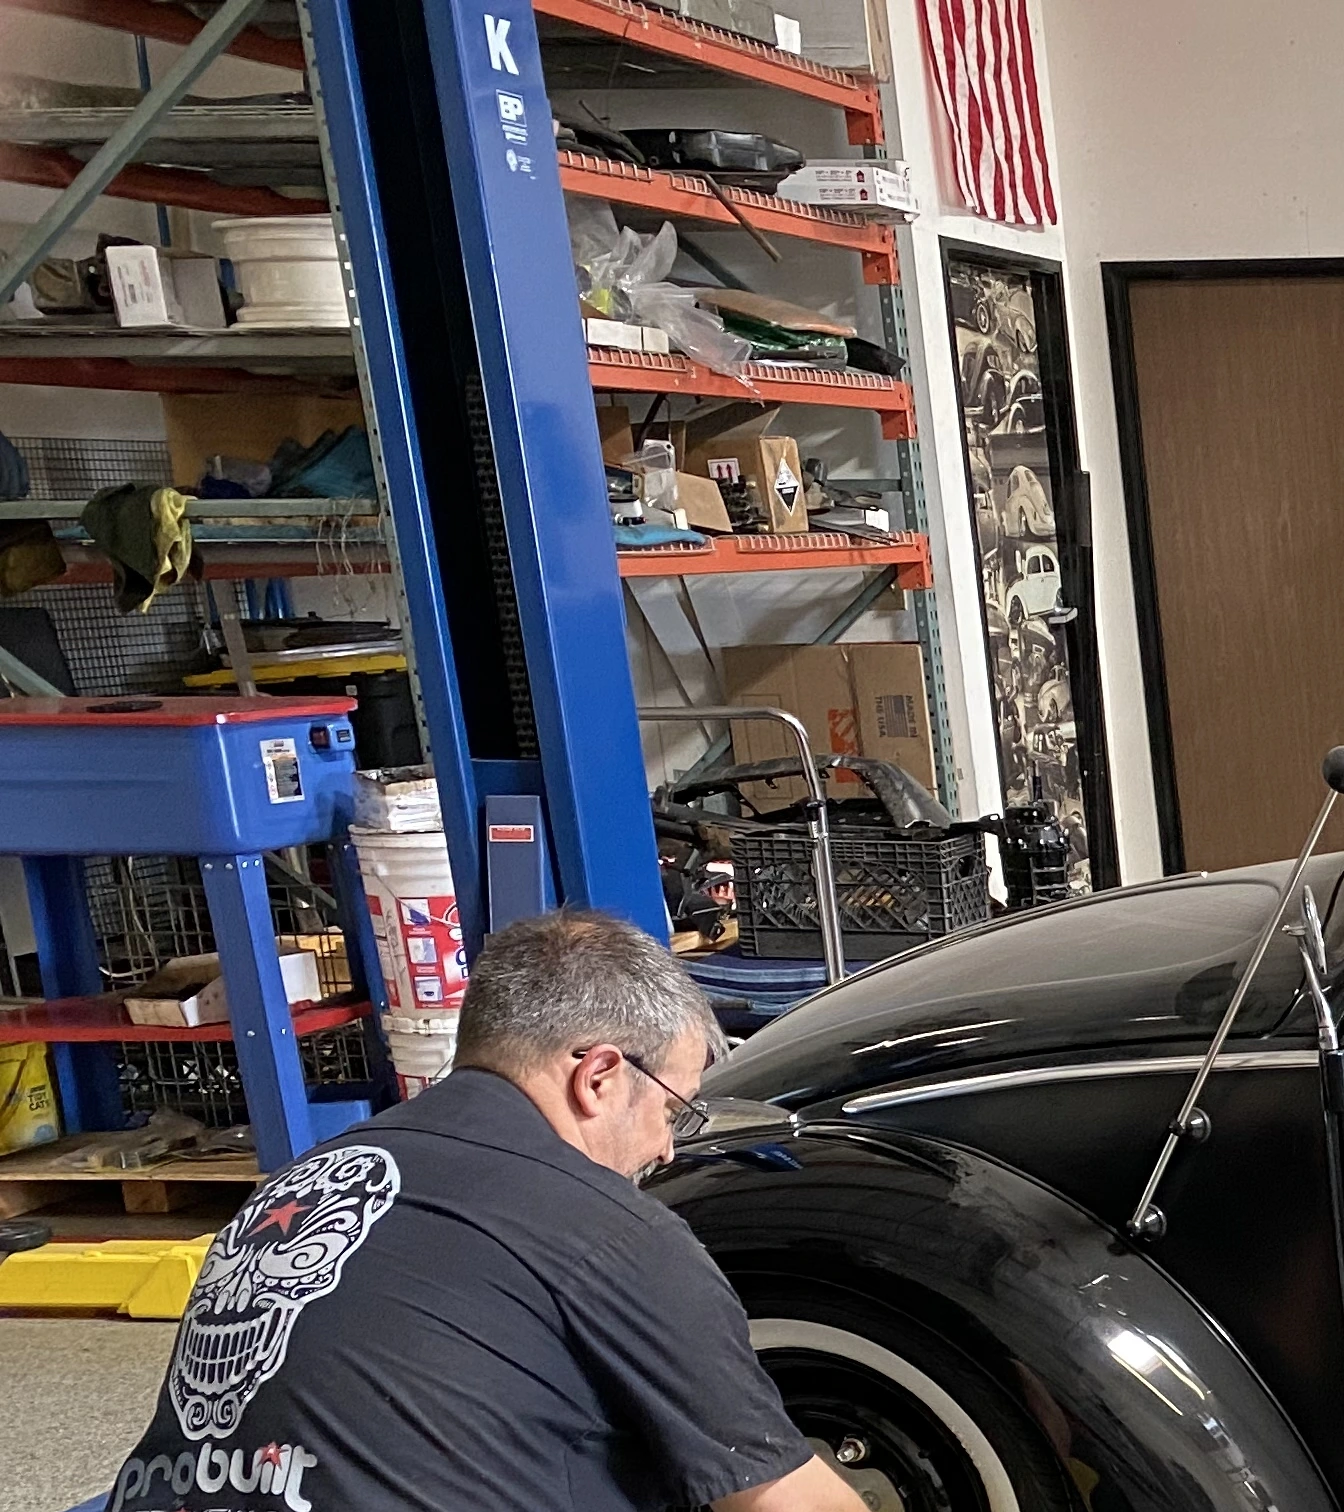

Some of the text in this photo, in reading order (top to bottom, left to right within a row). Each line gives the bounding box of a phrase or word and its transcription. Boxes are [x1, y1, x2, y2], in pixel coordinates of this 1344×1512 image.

[484, 14, 520, 76] K
[906, 695, 916, 724] MADE
[877, 717, 886, 738] USA
